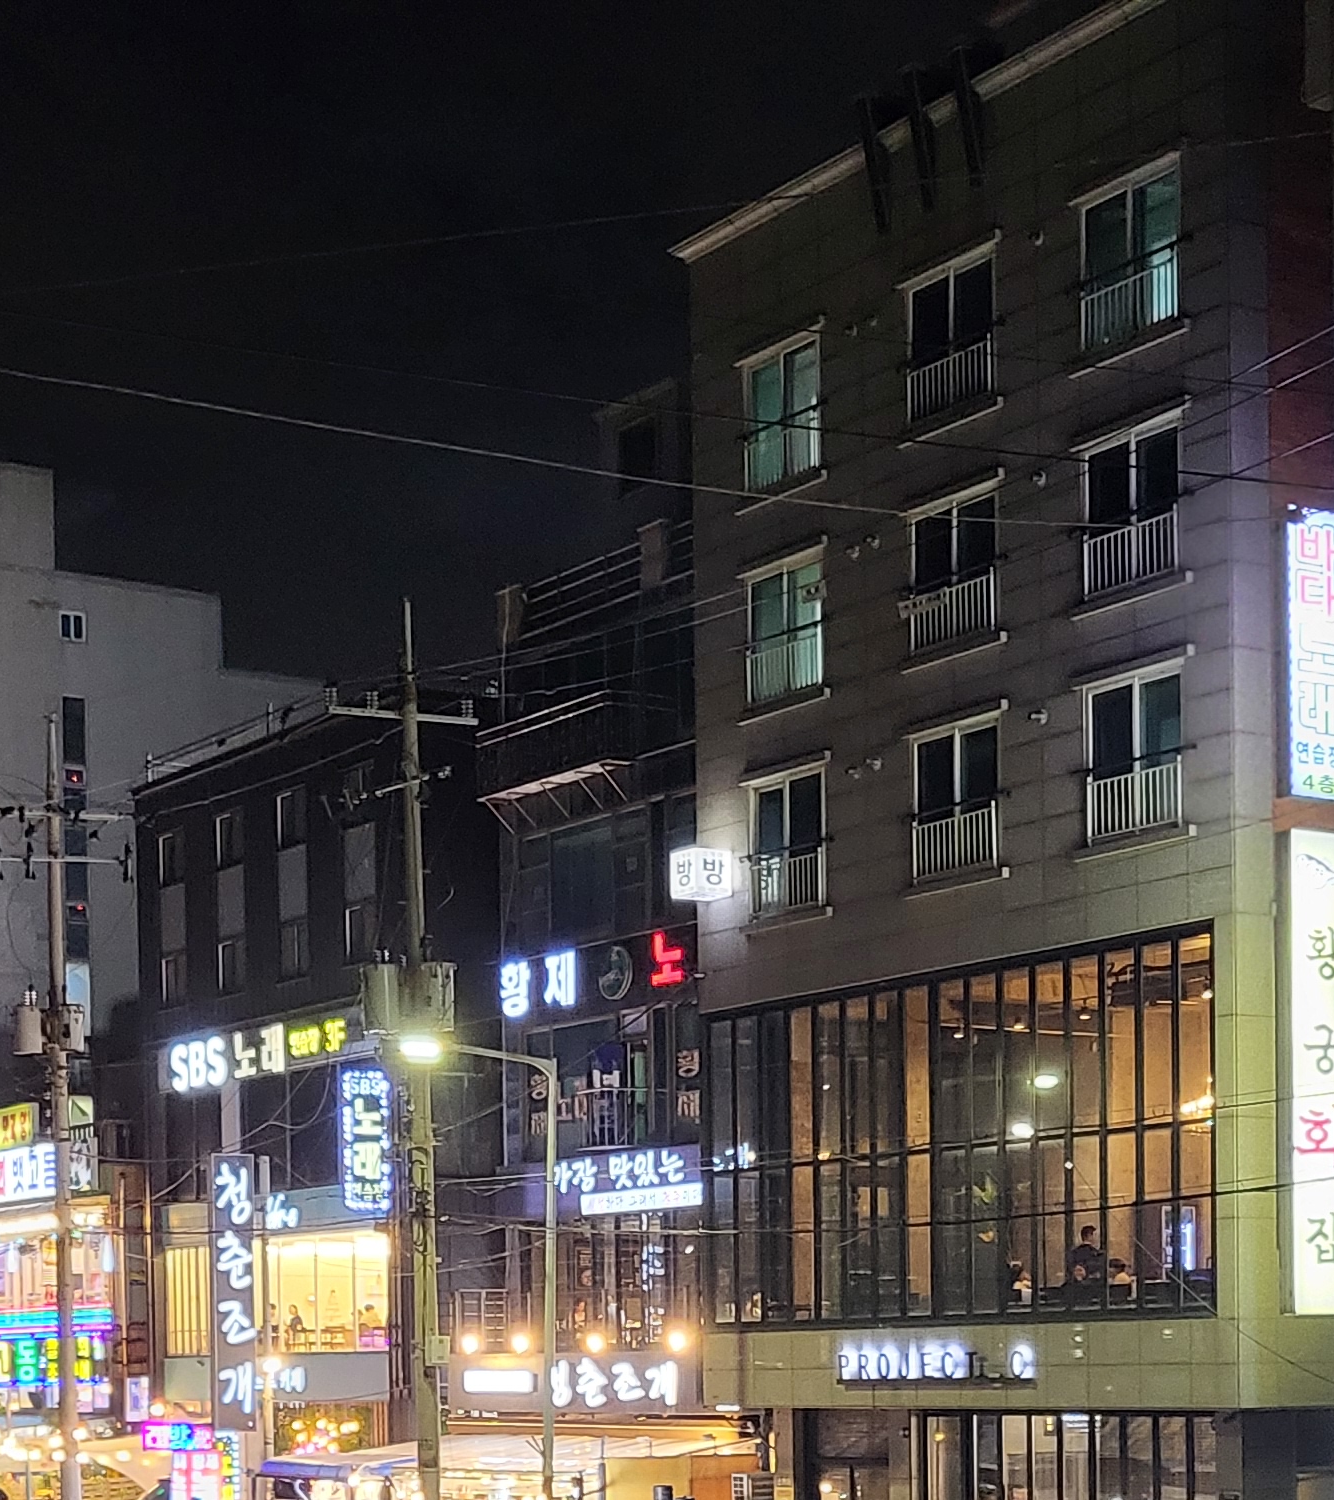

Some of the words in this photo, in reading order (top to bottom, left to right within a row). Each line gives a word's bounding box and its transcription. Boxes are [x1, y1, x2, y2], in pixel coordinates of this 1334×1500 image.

[703, 858, 725, 885] 방
[500, 949, 577, 1018] 황제
[650, 929, 684, 987] 노
[170, 1036, 227, 1092] SBS
[233, 1023, 285, 1079] 노래
[324, 1018, 346, 1052] 3F
[350, 1079, 381, 1095] SBS
[353, 1098, 382, 1180] 노래
[554, 1157, 597, 1193] 가장
[609, 1150, 685, 1189] 맛있는
[215, 1163, 257, 1414] 청춘조개
